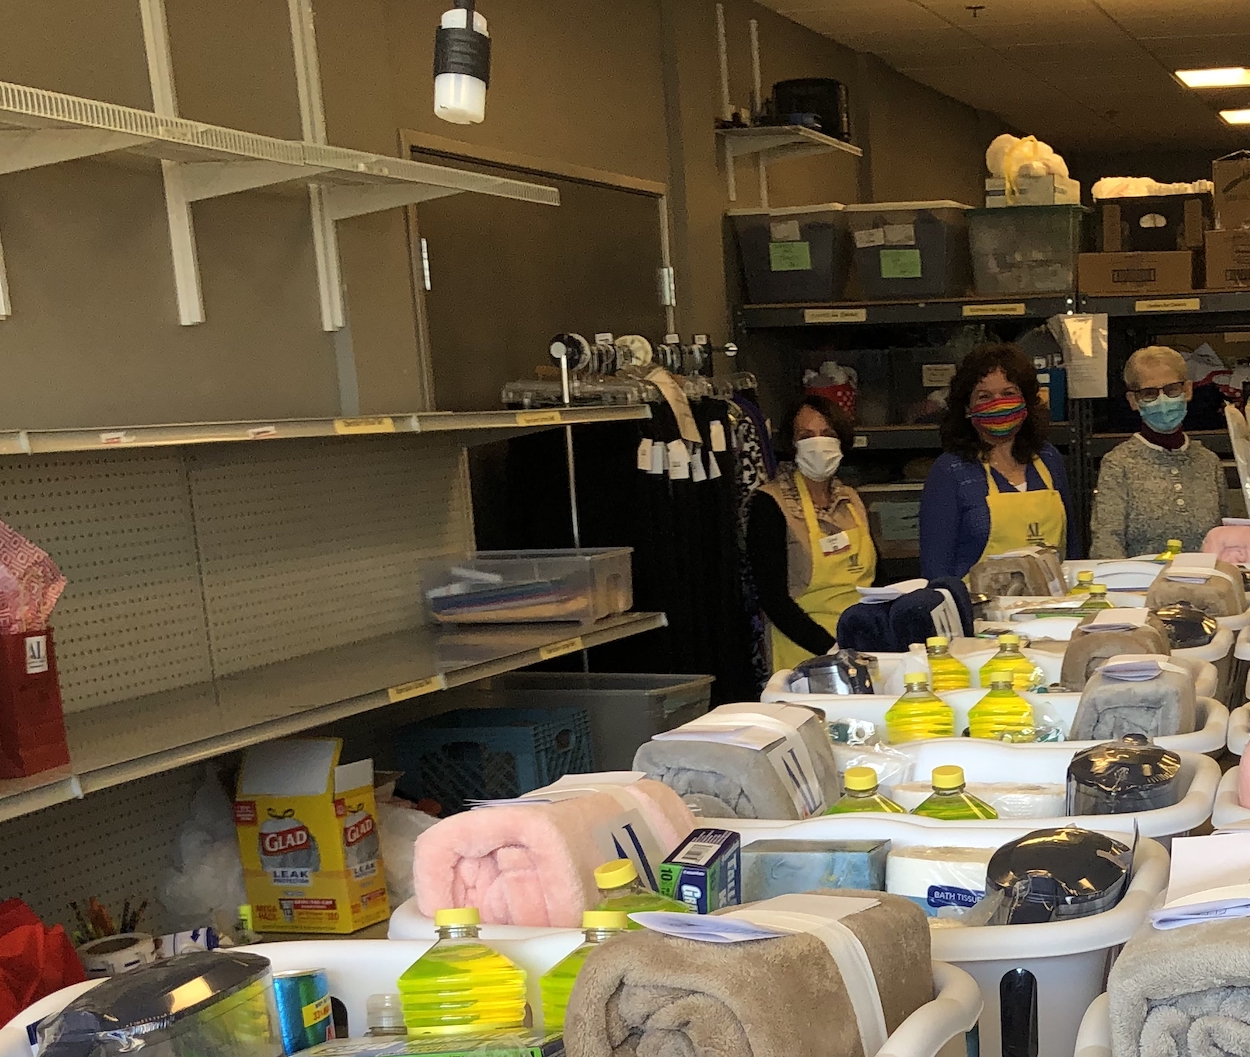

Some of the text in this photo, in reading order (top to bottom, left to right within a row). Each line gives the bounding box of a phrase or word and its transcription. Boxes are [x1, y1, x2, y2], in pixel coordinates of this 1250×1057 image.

[347, 818, 373, 843] GLAD
[264, 829, 308, 852] GLAD
[273, 870, 308, 878] LEAK
[354, 863, 376, 874] LEAK
[661, 868, 673, 881] 10
[934, 891, 956, 900] BATH
